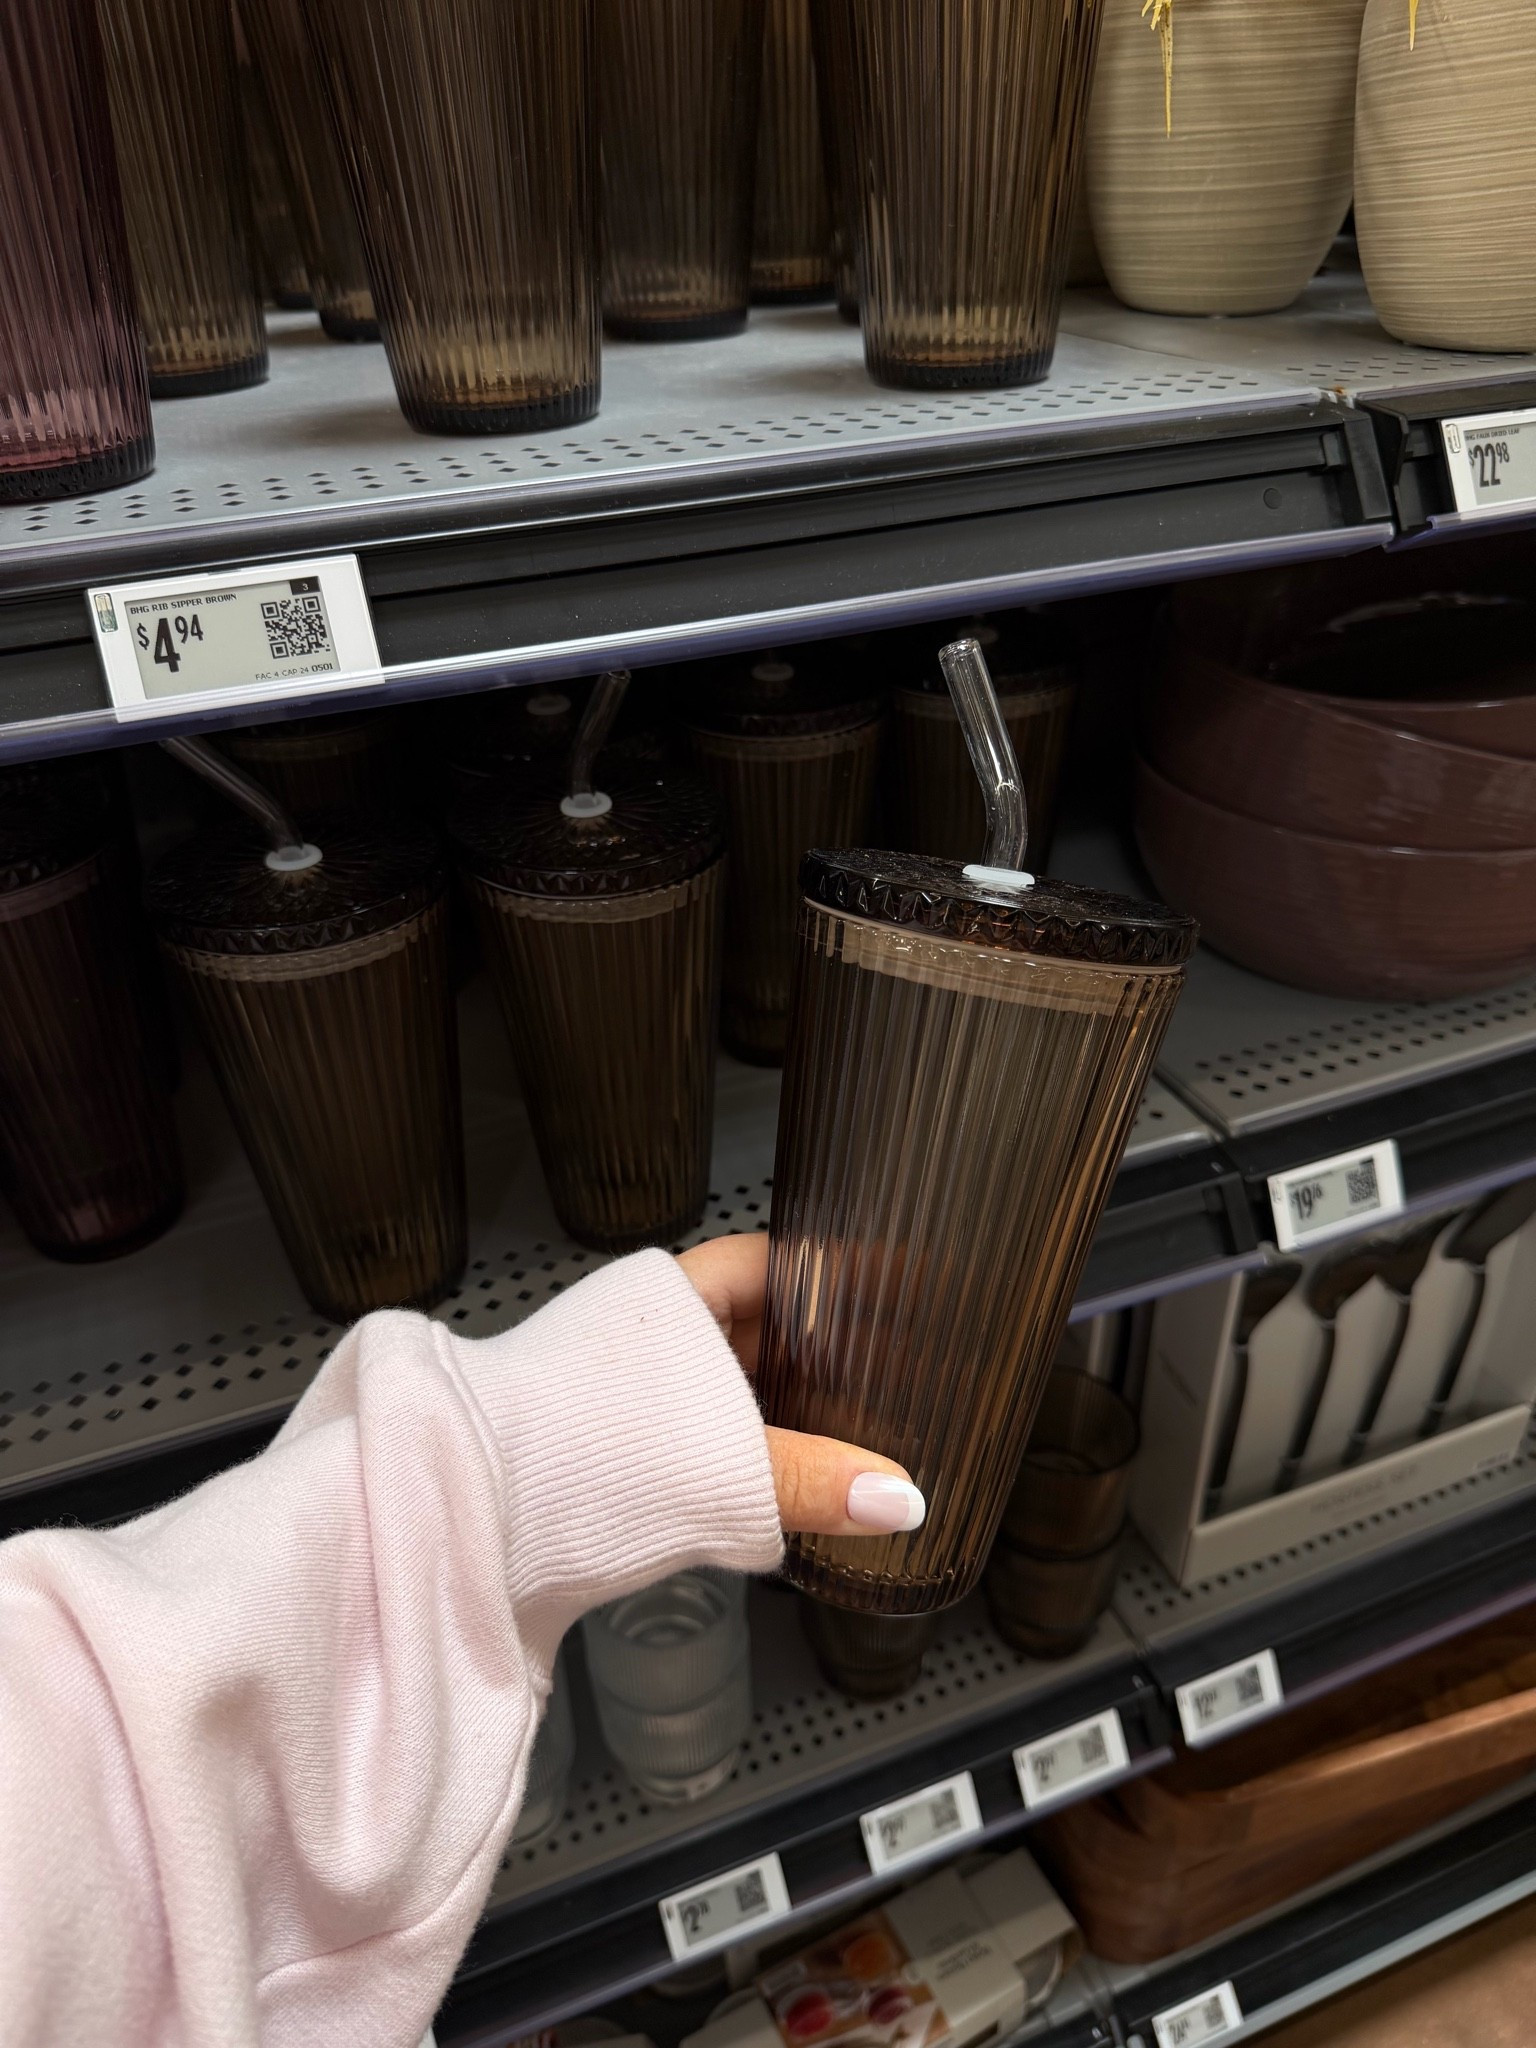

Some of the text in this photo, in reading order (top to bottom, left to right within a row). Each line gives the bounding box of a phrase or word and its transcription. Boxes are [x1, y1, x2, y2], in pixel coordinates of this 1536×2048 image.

[302, 583, 309, 591] 3
[130, 593, 237, 615] BHG RIB SIPPER BROWN
[281, 668, 298, 677] CAP
[300, 666, 309, 674] 24
[311, 662, 334, 673] 0501
